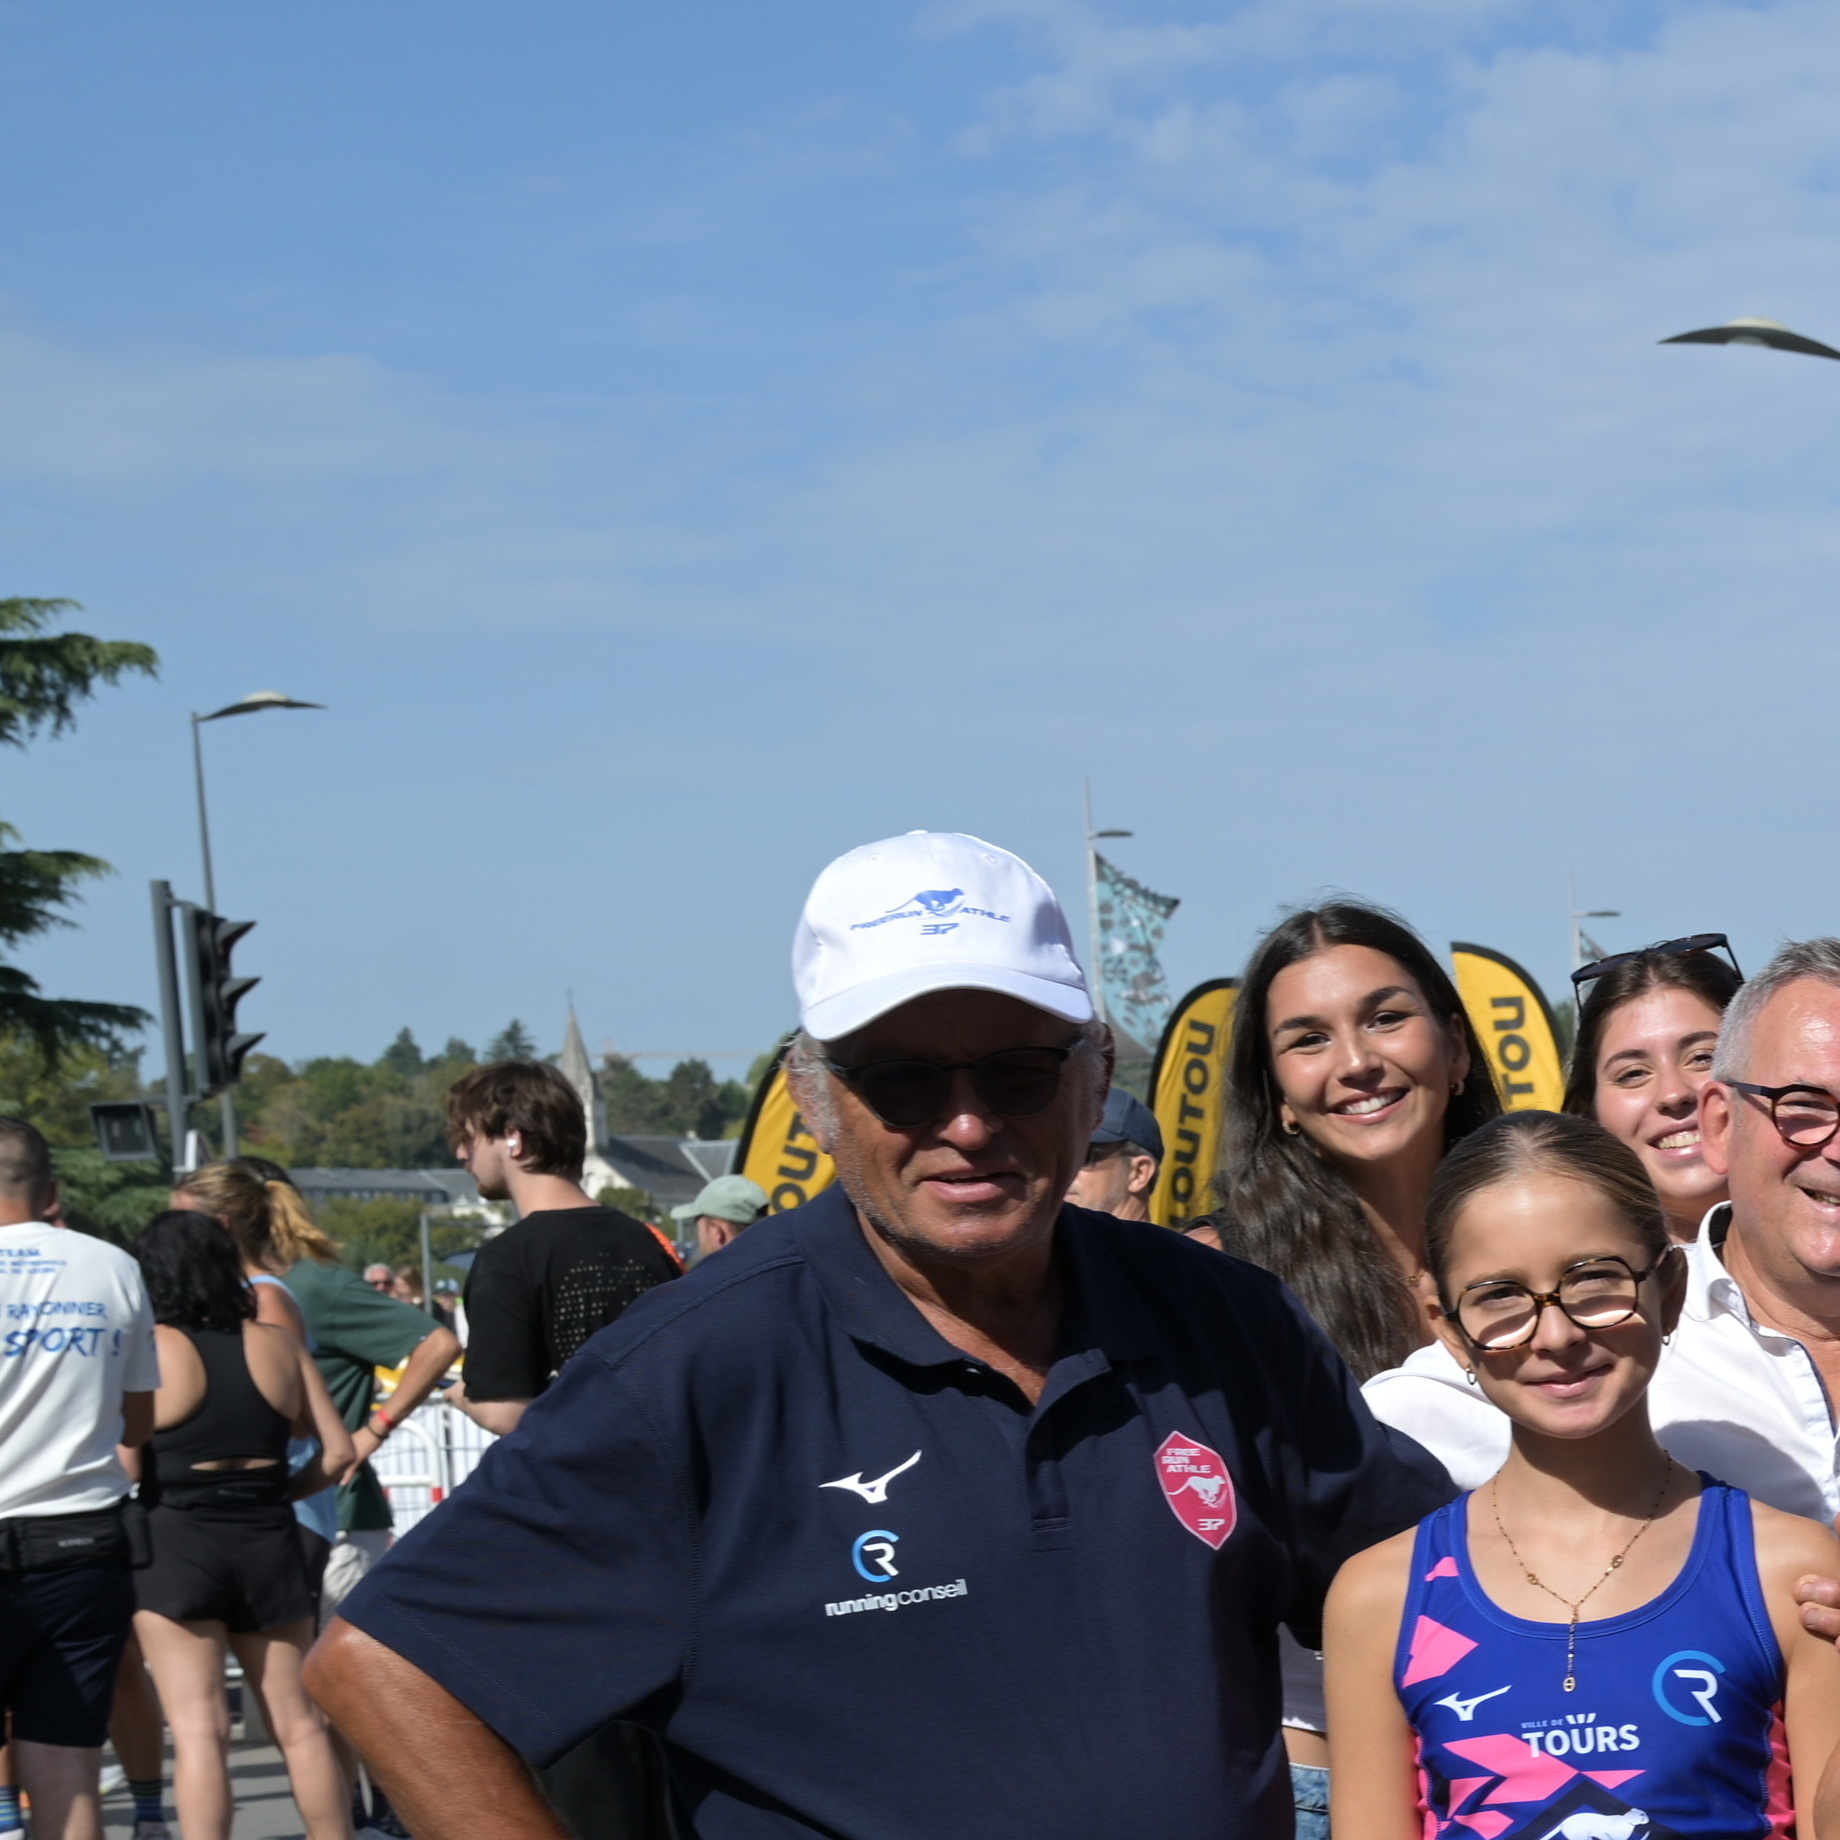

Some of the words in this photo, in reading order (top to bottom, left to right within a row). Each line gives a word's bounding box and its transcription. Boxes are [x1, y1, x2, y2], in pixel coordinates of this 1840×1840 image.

[920, 923, 959, 935] 37
[5, 1327, 105, 1357] SPORT
[1166, 1448, 1201, 1456] FREE
[1161, 1456, 1191, 1464] RUN
[1166, 1465, 1212, 1473] ATHLE
[1198, 1519, 1225, 1530] 37
[825, 1578, 968, 1617] runningconseil
[1522, 1724, 1640, 1757] TOURS
